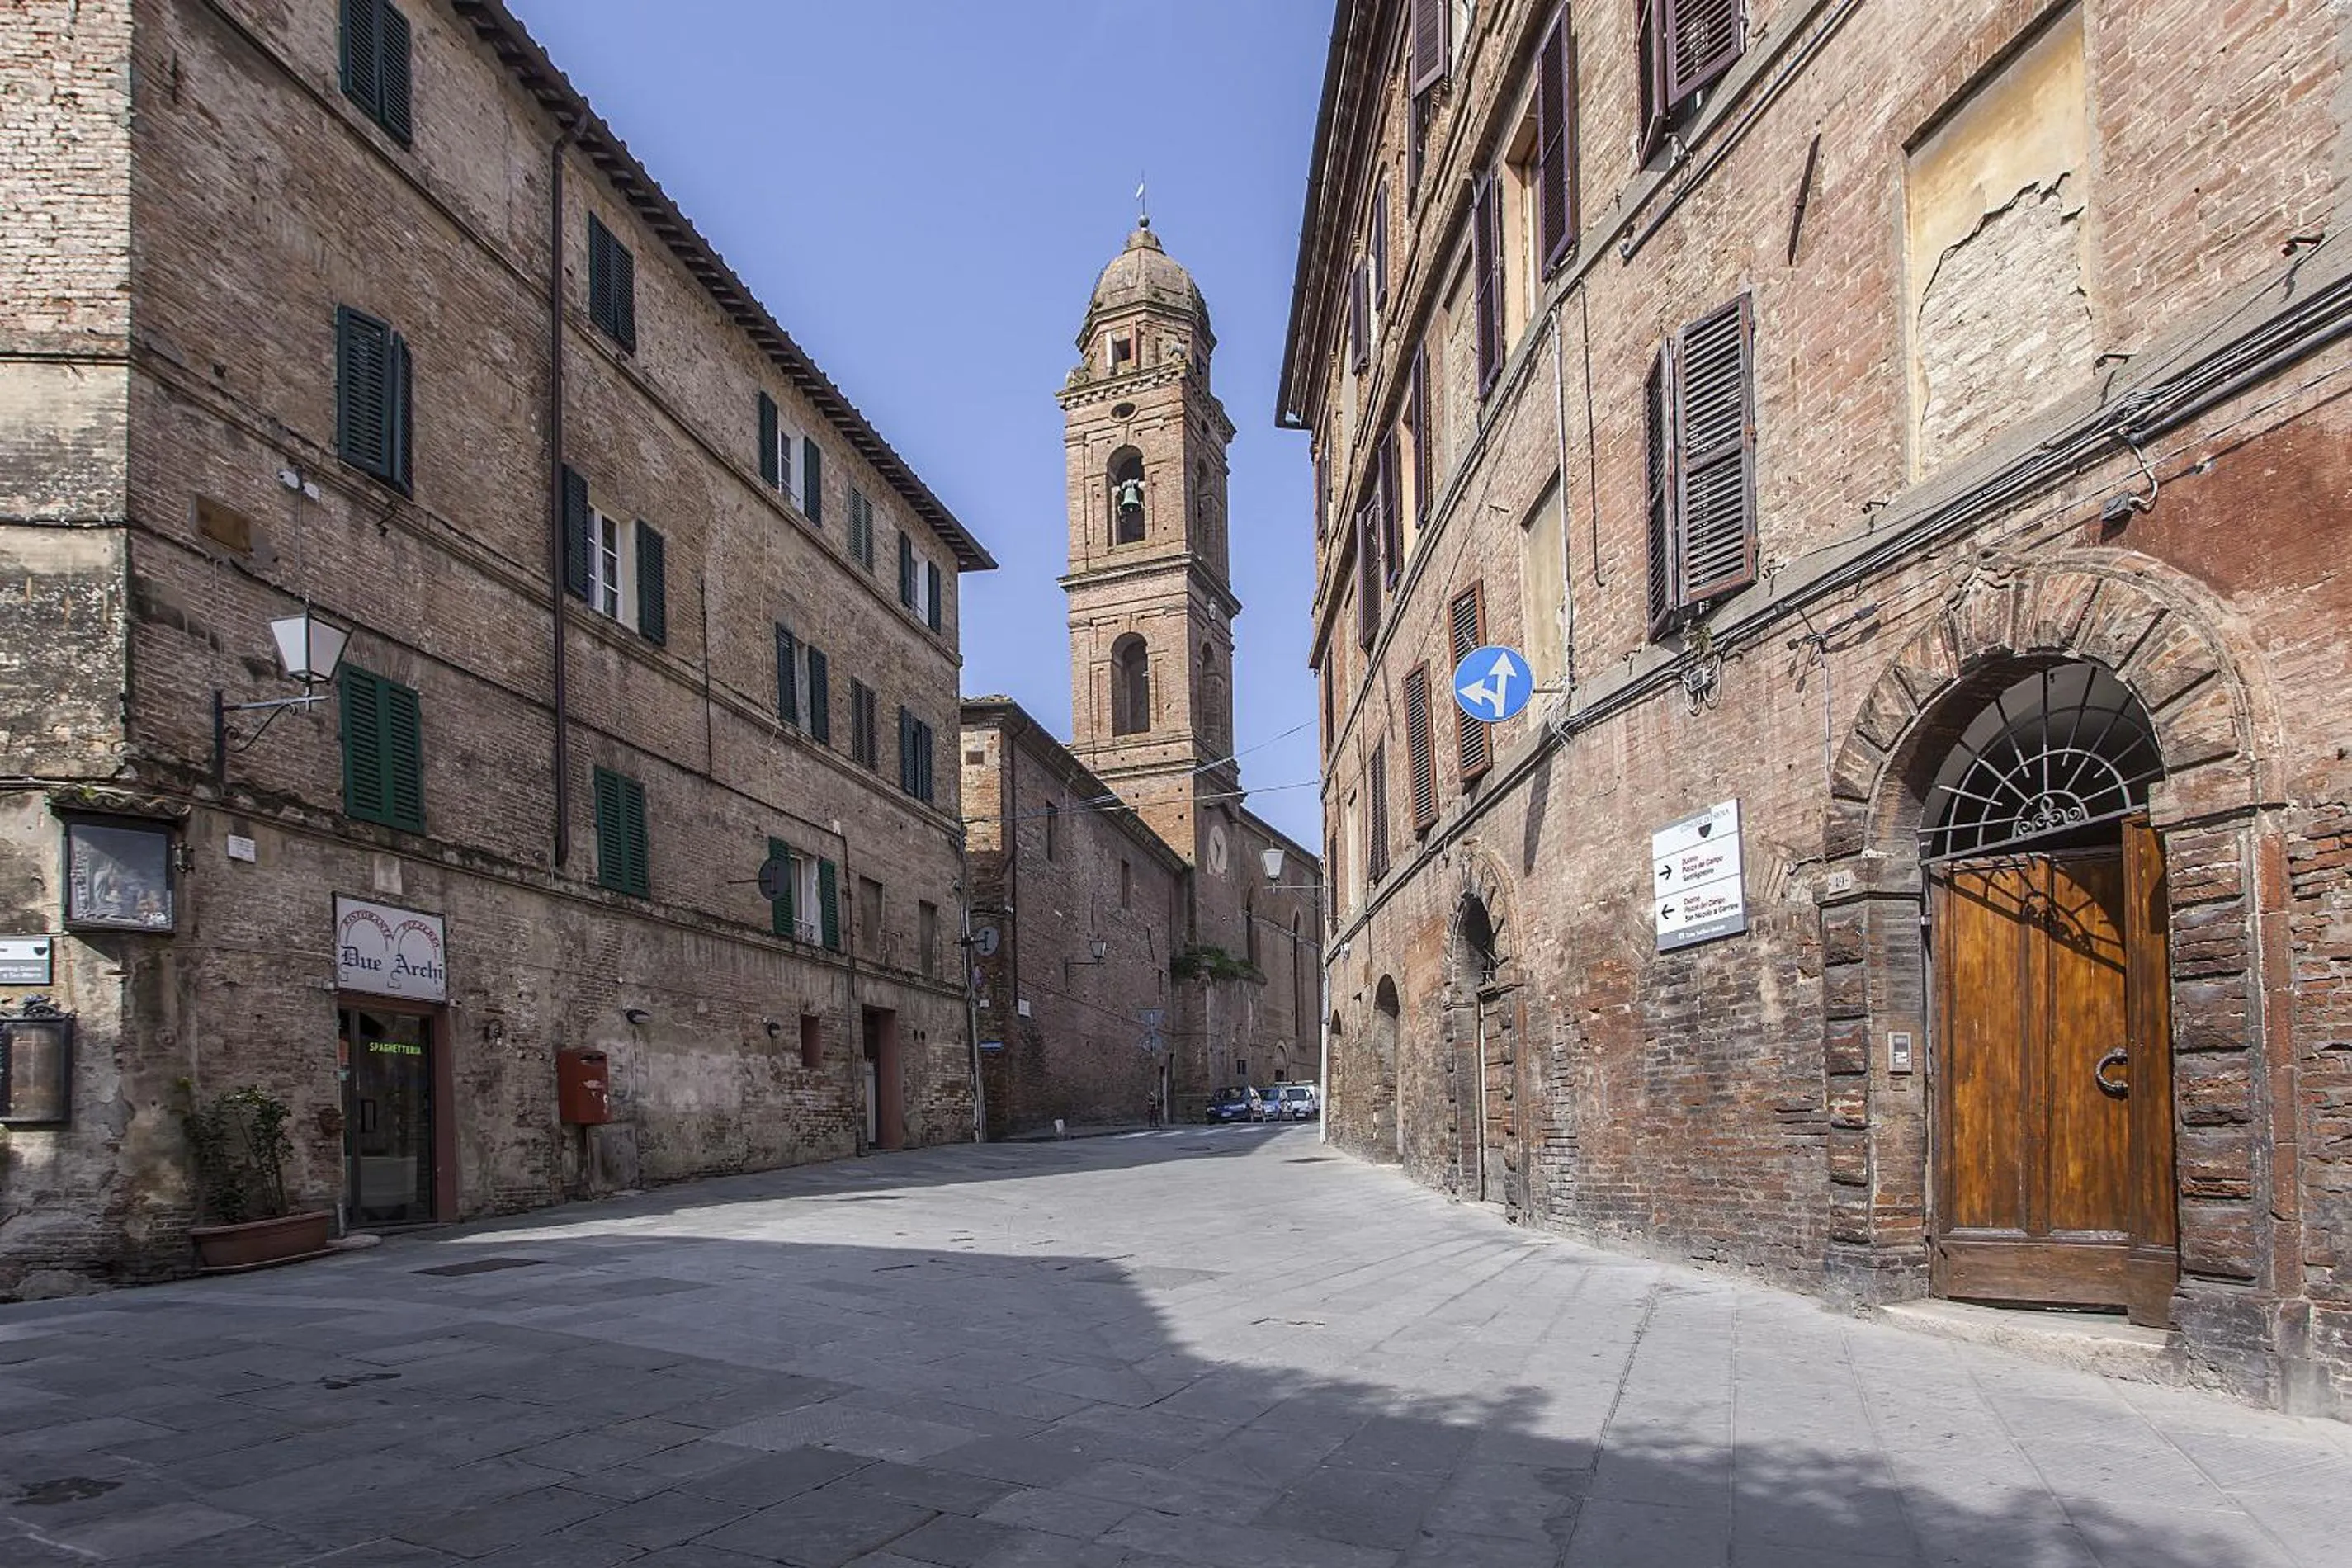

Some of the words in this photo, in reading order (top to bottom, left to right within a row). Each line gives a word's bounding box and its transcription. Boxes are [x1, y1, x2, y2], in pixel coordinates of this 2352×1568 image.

[1706, 855, 1723, 866] Campo
[342, 909, 394, 942] RISTORANTE
[402, 920, 440, 948] PIZZERIA
[340, 945, 382, 971] Due
[393, 953, 443, 982] Archi
[369, 1041, 421, 1055] SPAGHETTERIA
